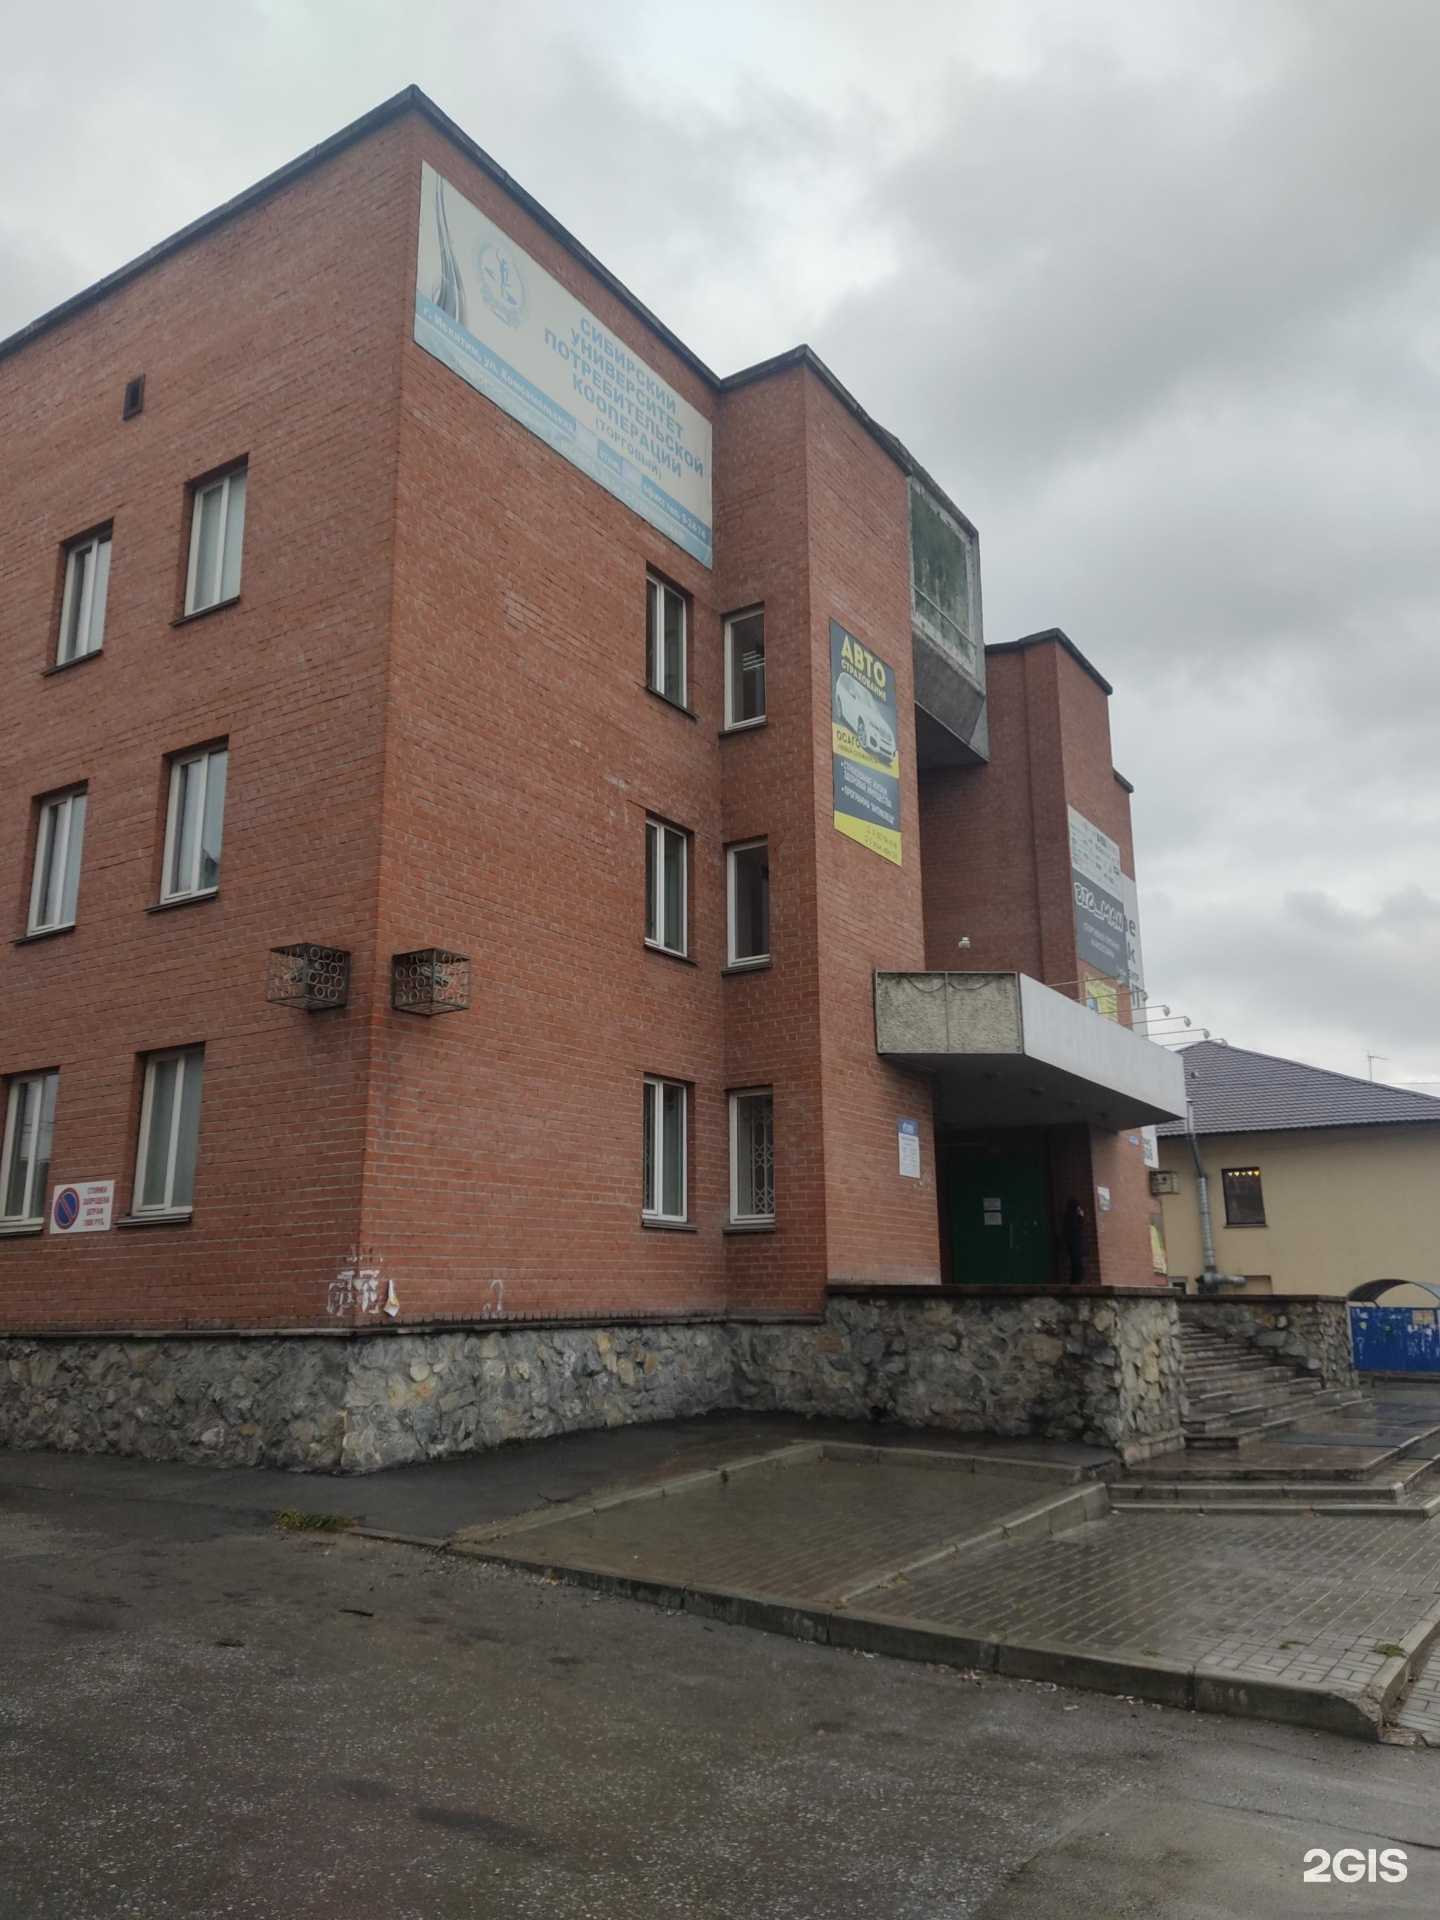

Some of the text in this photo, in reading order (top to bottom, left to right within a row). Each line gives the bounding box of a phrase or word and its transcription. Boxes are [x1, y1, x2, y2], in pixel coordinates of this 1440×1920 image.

[544, 327, 704, 478] ПОТРЕБИТЕЛЬСКОЙ
[570, 328, 684, 439] УНИВЕРСИТЕТ
[580, 317, 677, 414] СИБИРСКИЙ
[572, 373, 682, 478] КООПЕРАЦИИ
[841, 633, 886, 689] АВТО
